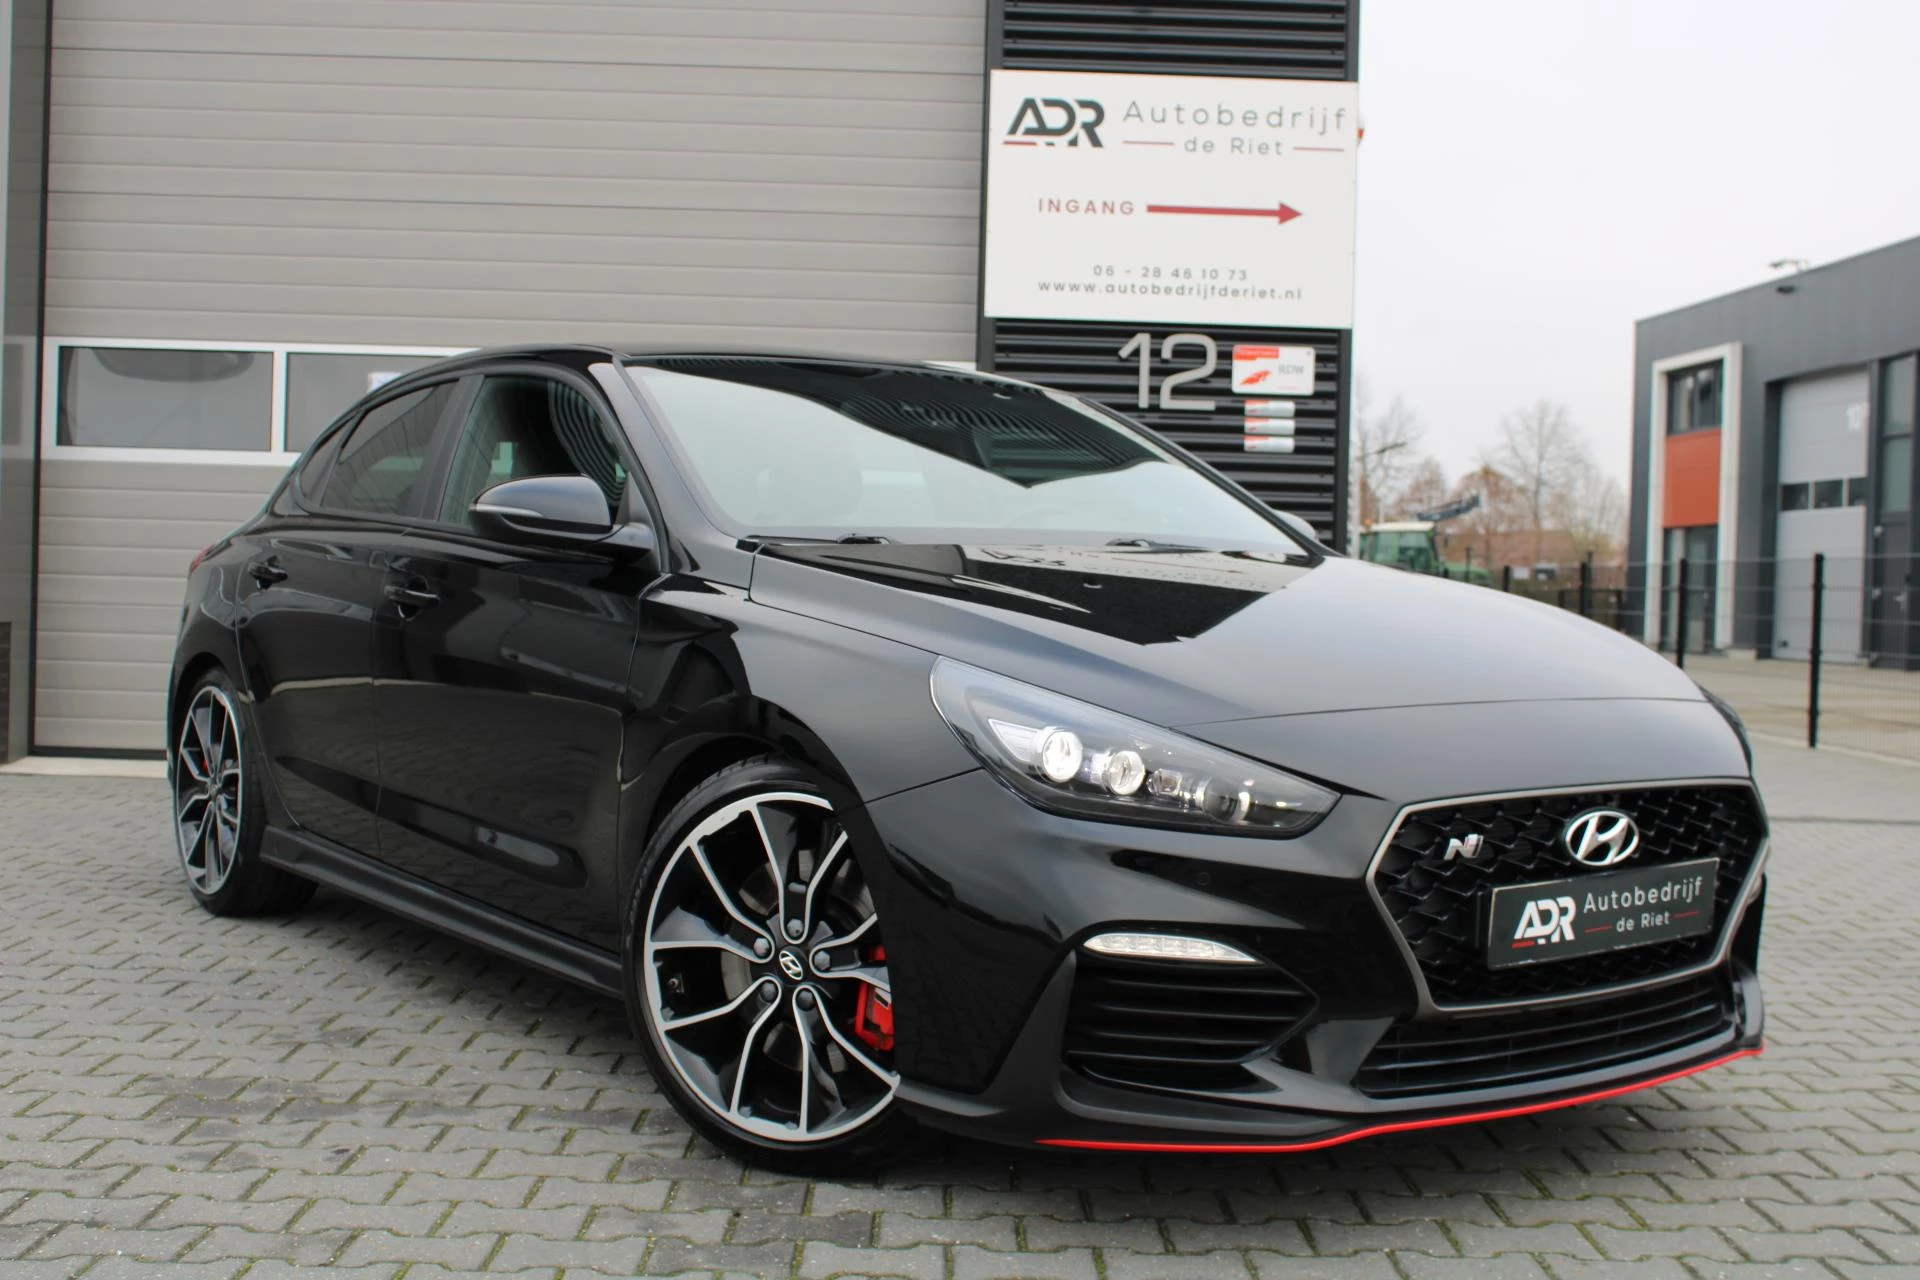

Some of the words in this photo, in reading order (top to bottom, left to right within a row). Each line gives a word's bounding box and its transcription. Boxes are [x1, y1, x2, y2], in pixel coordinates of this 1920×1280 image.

[1006, 98, 1105, 148] ADR
[1122, 100, 1346, 136] Autobedrijf
[1184, 136, 1215, 154] de
[1230, 137, 1283, 156] Riet
[1038, 198, 1135, 216] INGANG
[1093, 265, 1115, 277] 06
[1141, 266, 1162, 279] 28
[1171, 268, 1193, 280] 46
[1201, 268, 1219, 281] 10
[1228, 269, 1249, 282] 73
[1118, 332, 1217, 411] 12
[1583, 876, 1702, 913] Autobedrijf
[1513, 896, 1576, 944] ADR
[1616, 916, 1635, 933] de
[1641, 912, 1671, 930] Riet
